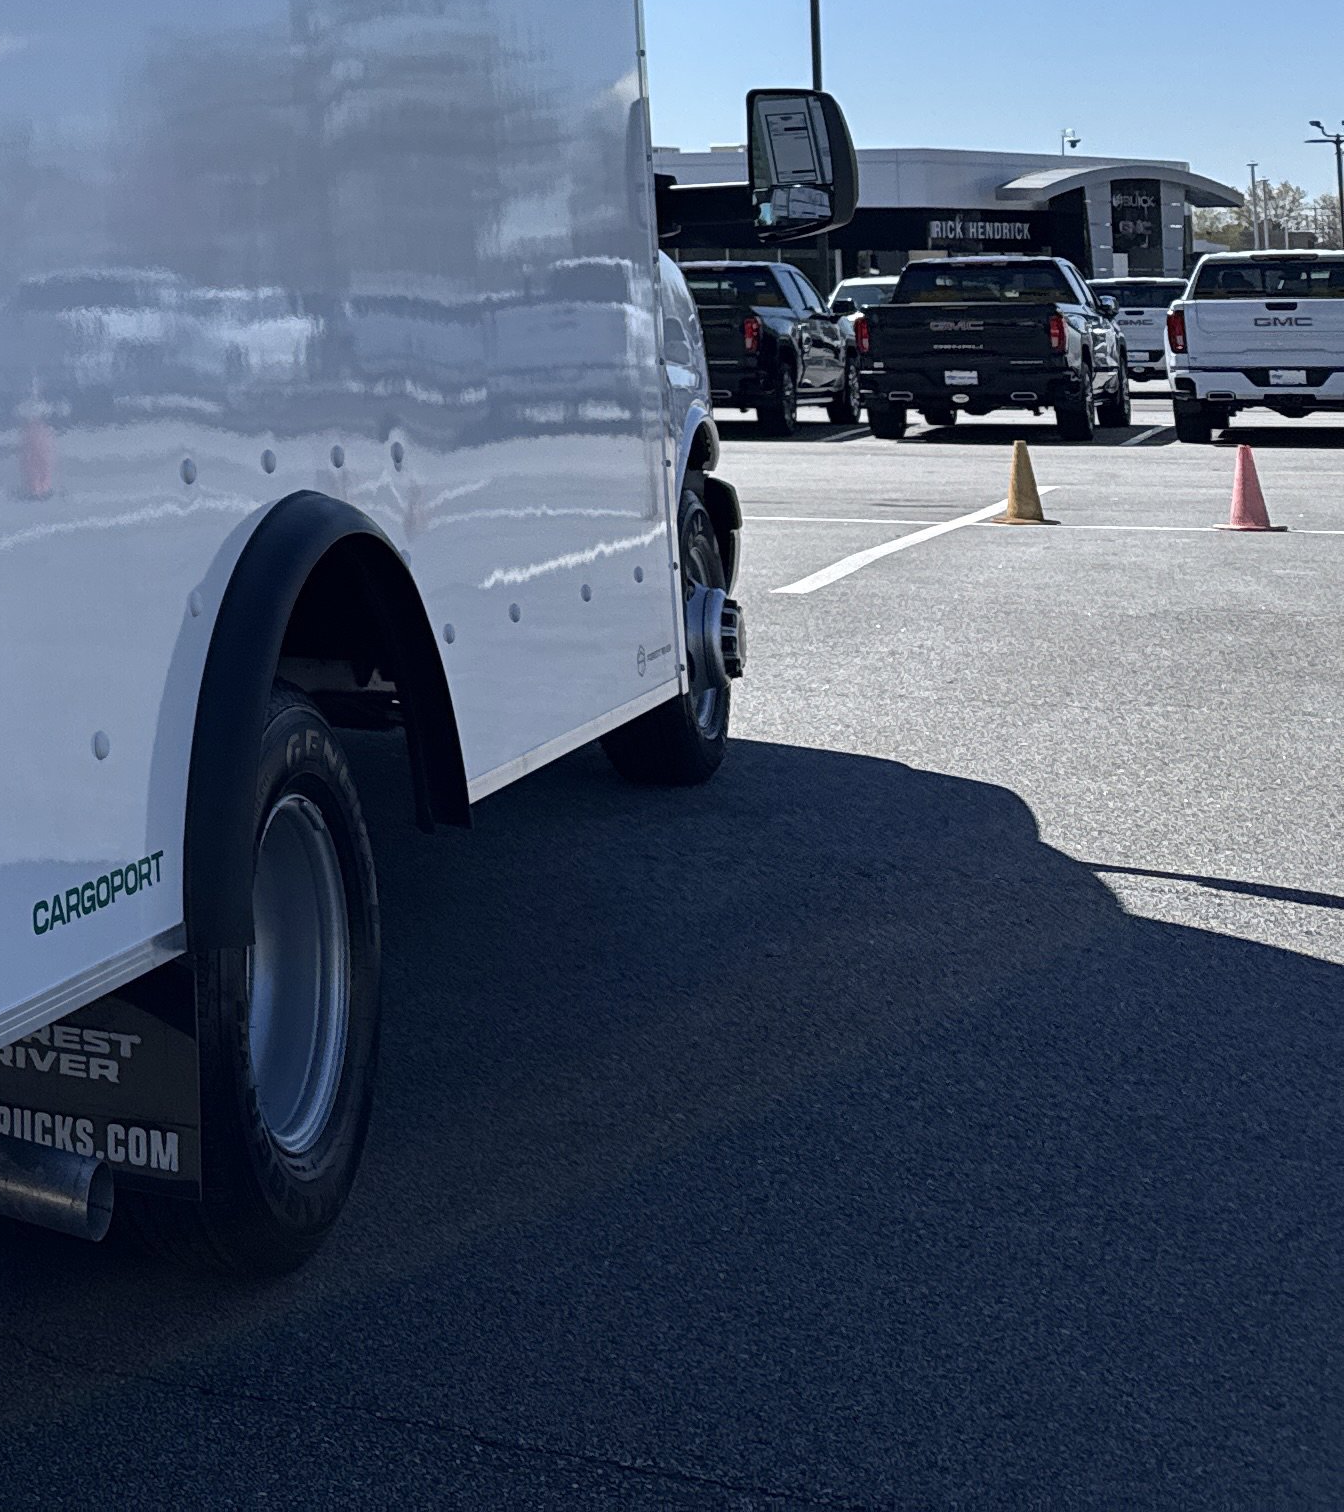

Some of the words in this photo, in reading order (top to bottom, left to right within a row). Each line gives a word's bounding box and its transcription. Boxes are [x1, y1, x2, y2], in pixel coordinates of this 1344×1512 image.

[930, 220, 963, 239] RICK
[969, 221, 1031, 240] HENDRICK
[930, 320, 984, 331] GMC
[1254, 317, 1313, 327] GMC
[32, 850, 164, 935] CARGOPORT
